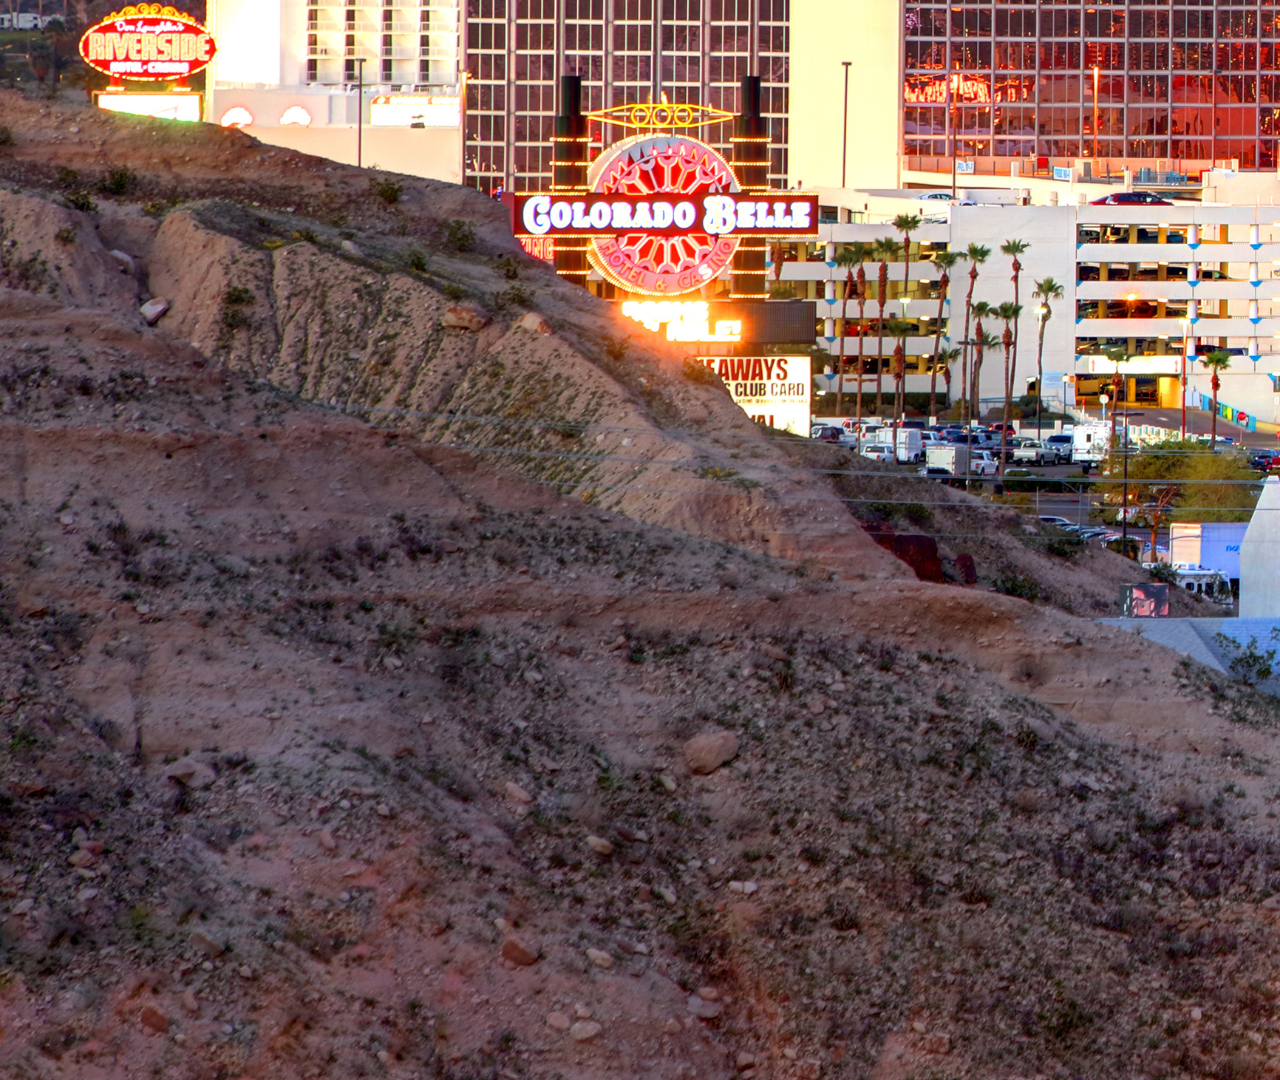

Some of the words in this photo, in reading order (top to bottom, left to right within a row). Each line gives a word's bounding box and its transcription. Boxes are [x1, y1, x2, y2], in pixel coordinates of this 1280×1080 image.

[88, 32, 211, 61] RIVERSIDE
[522, 195, 697, 235] COLORADO
[702, 194, 812, 235] BELLE
[601, 240, 646, 287] HOTEL
[655, 276, 668, 291] &
[678, 240, 734, 288] CASINO
[735, 382, 767, 397] CLUB
[770, 382, 805, 396] CARD
